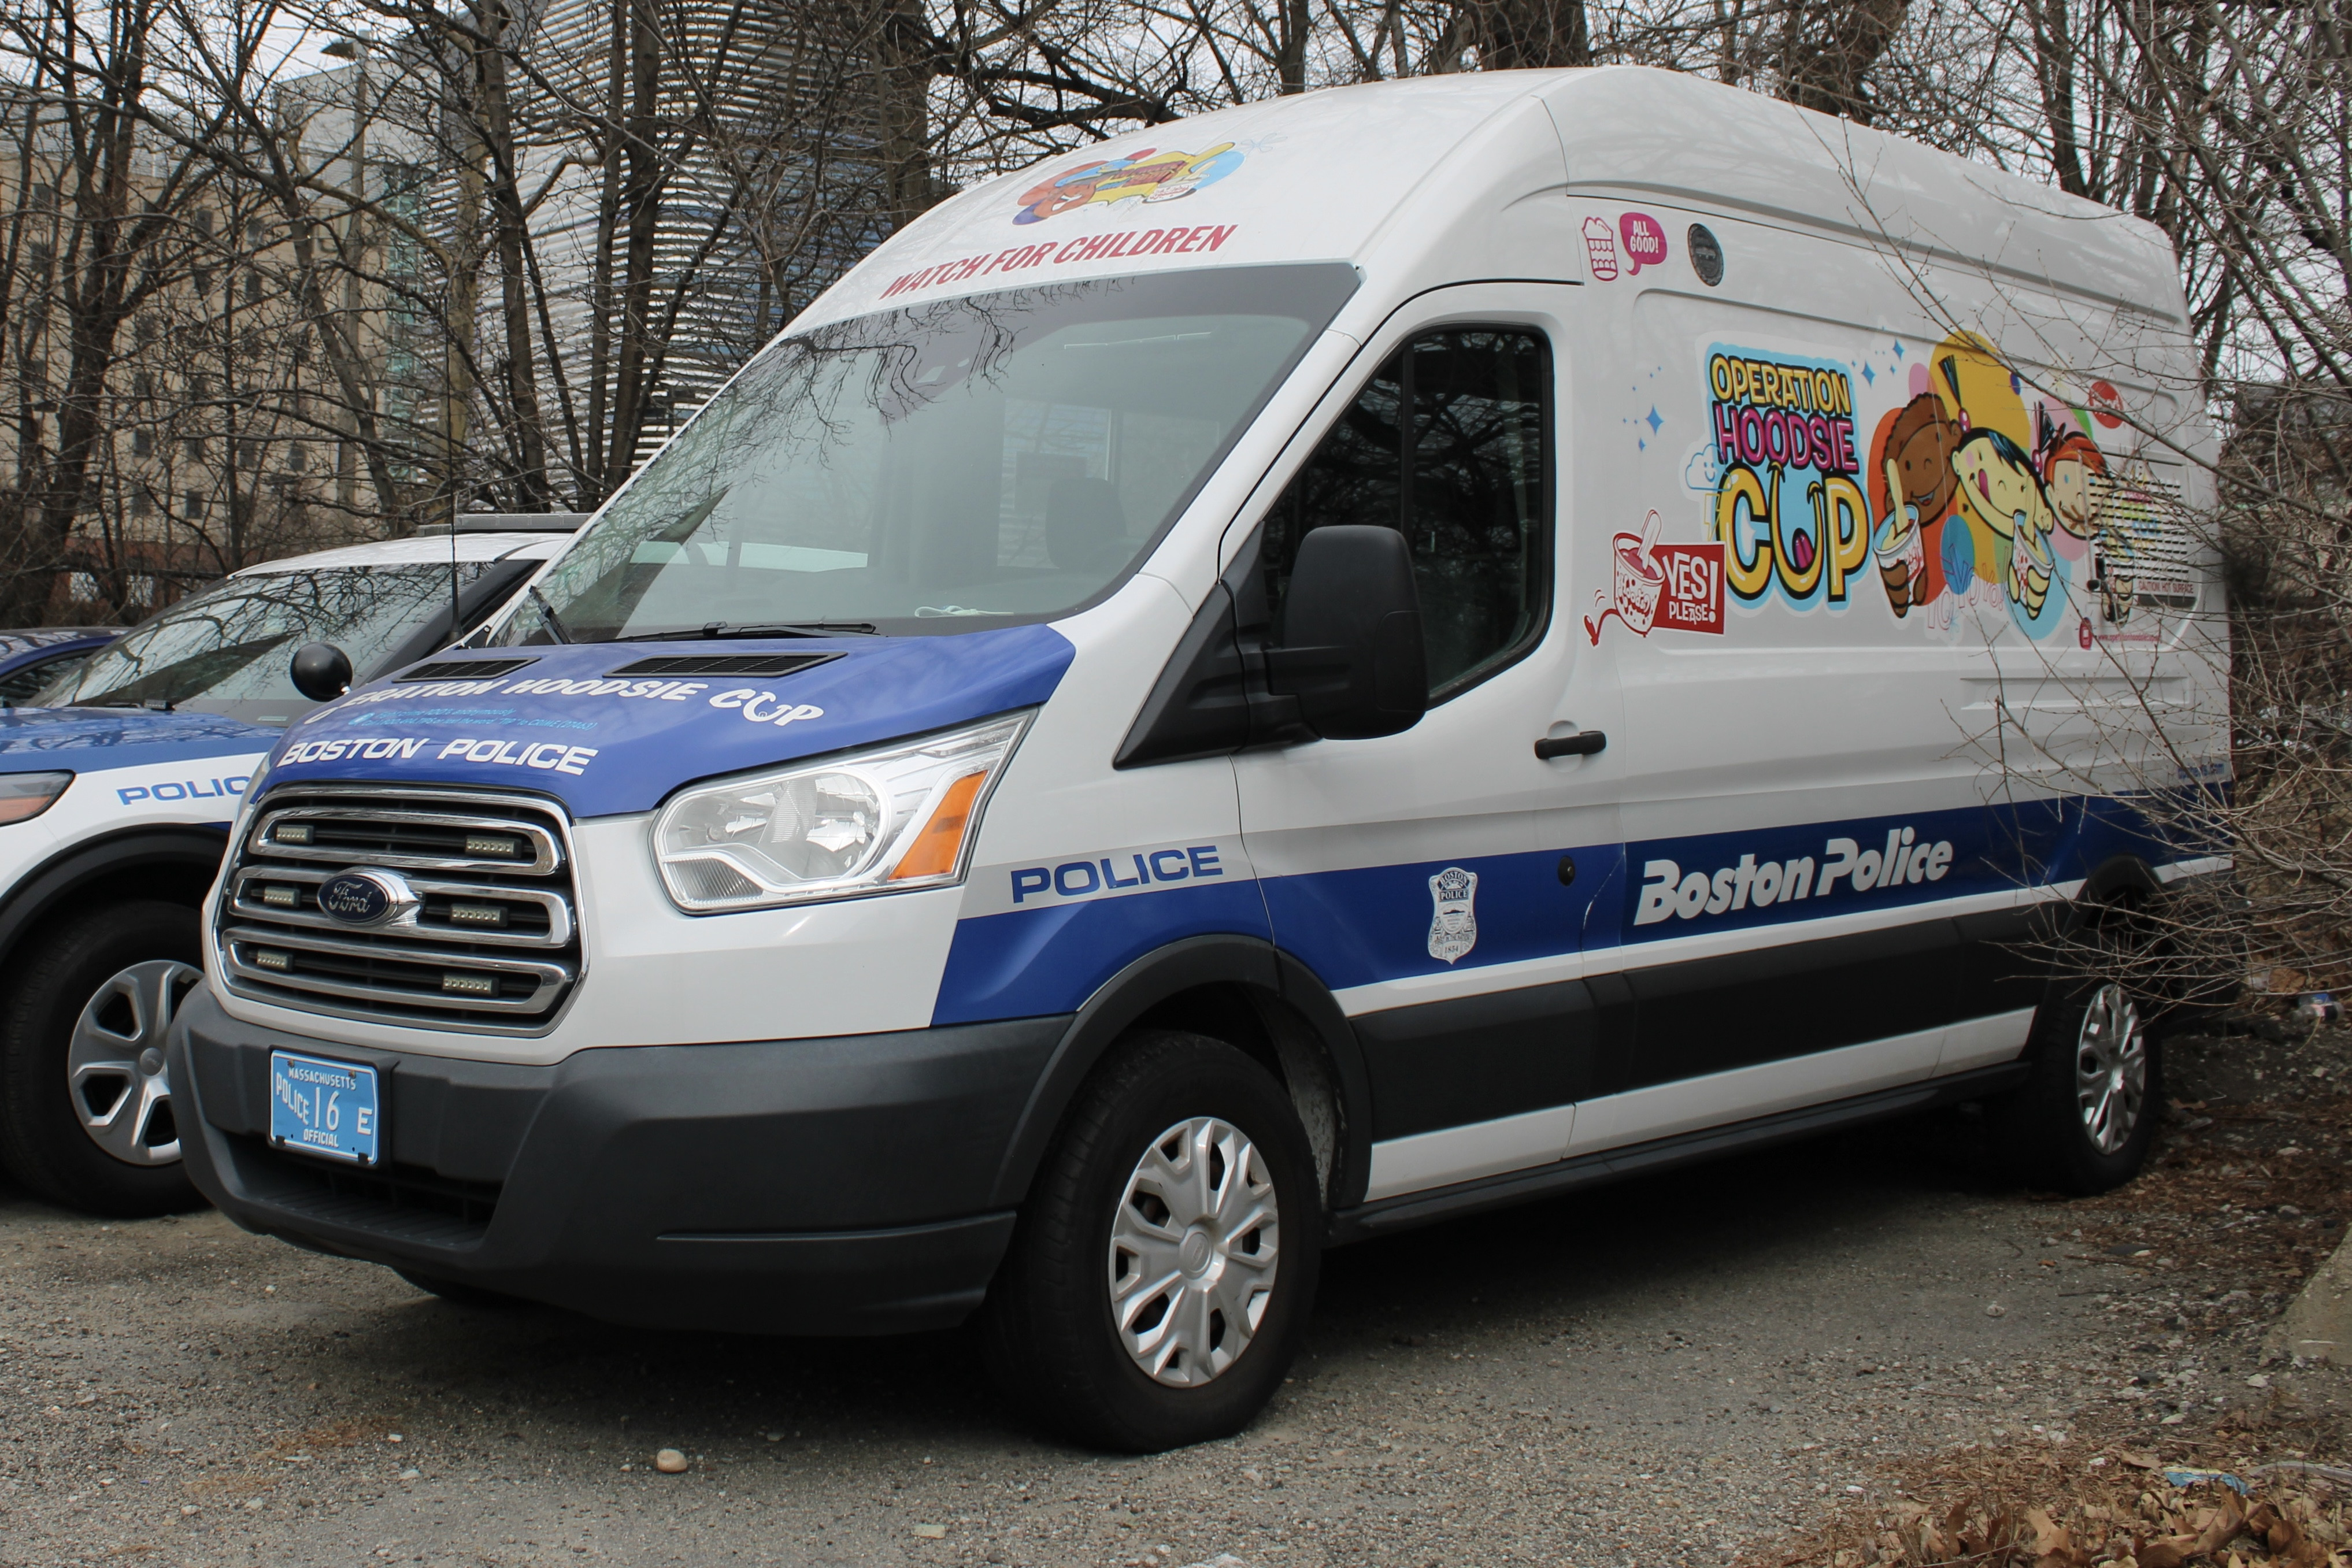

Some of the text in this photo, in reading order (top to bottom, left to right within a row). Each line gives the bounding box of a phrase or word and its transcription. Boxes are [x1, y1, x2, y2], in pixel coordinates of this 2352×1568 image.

[1629, 236, 1660, 254] GOOD!
[1633, 220, 1650, 236] ALL
[878, 224, 1239, 301] WATCH FOR CHILDREN
[1709, 353, 1852, 414] OPERATION
[1713, 401, 1860, 474] HOODSIE
[1716, 461, 1871, 603] CUP
[1662, 551, 1718, 623] YES!
[501, 679, 709, 700] HOODSIE
[709, 688, 825, 726] CUP
[276, 738, 599, 776] BOSTON POLICE
[116, 775, 251, 806] POLIC
[1010, 845, 1224, 903] POLICE
[1439, 871, 1467, 884] BOSTON
[1440, 890, 1468, 900] POLICE
[1634, 826, 1953, 925] Boston Police
[328, 881, 372, 913] Ford
[288, 1067, 356, 1091] MASSACHUSETTS
[276, 1072, 373, 1135] POLICE 16 E
[303, 1128, 339, 1148] OFFICIAL
